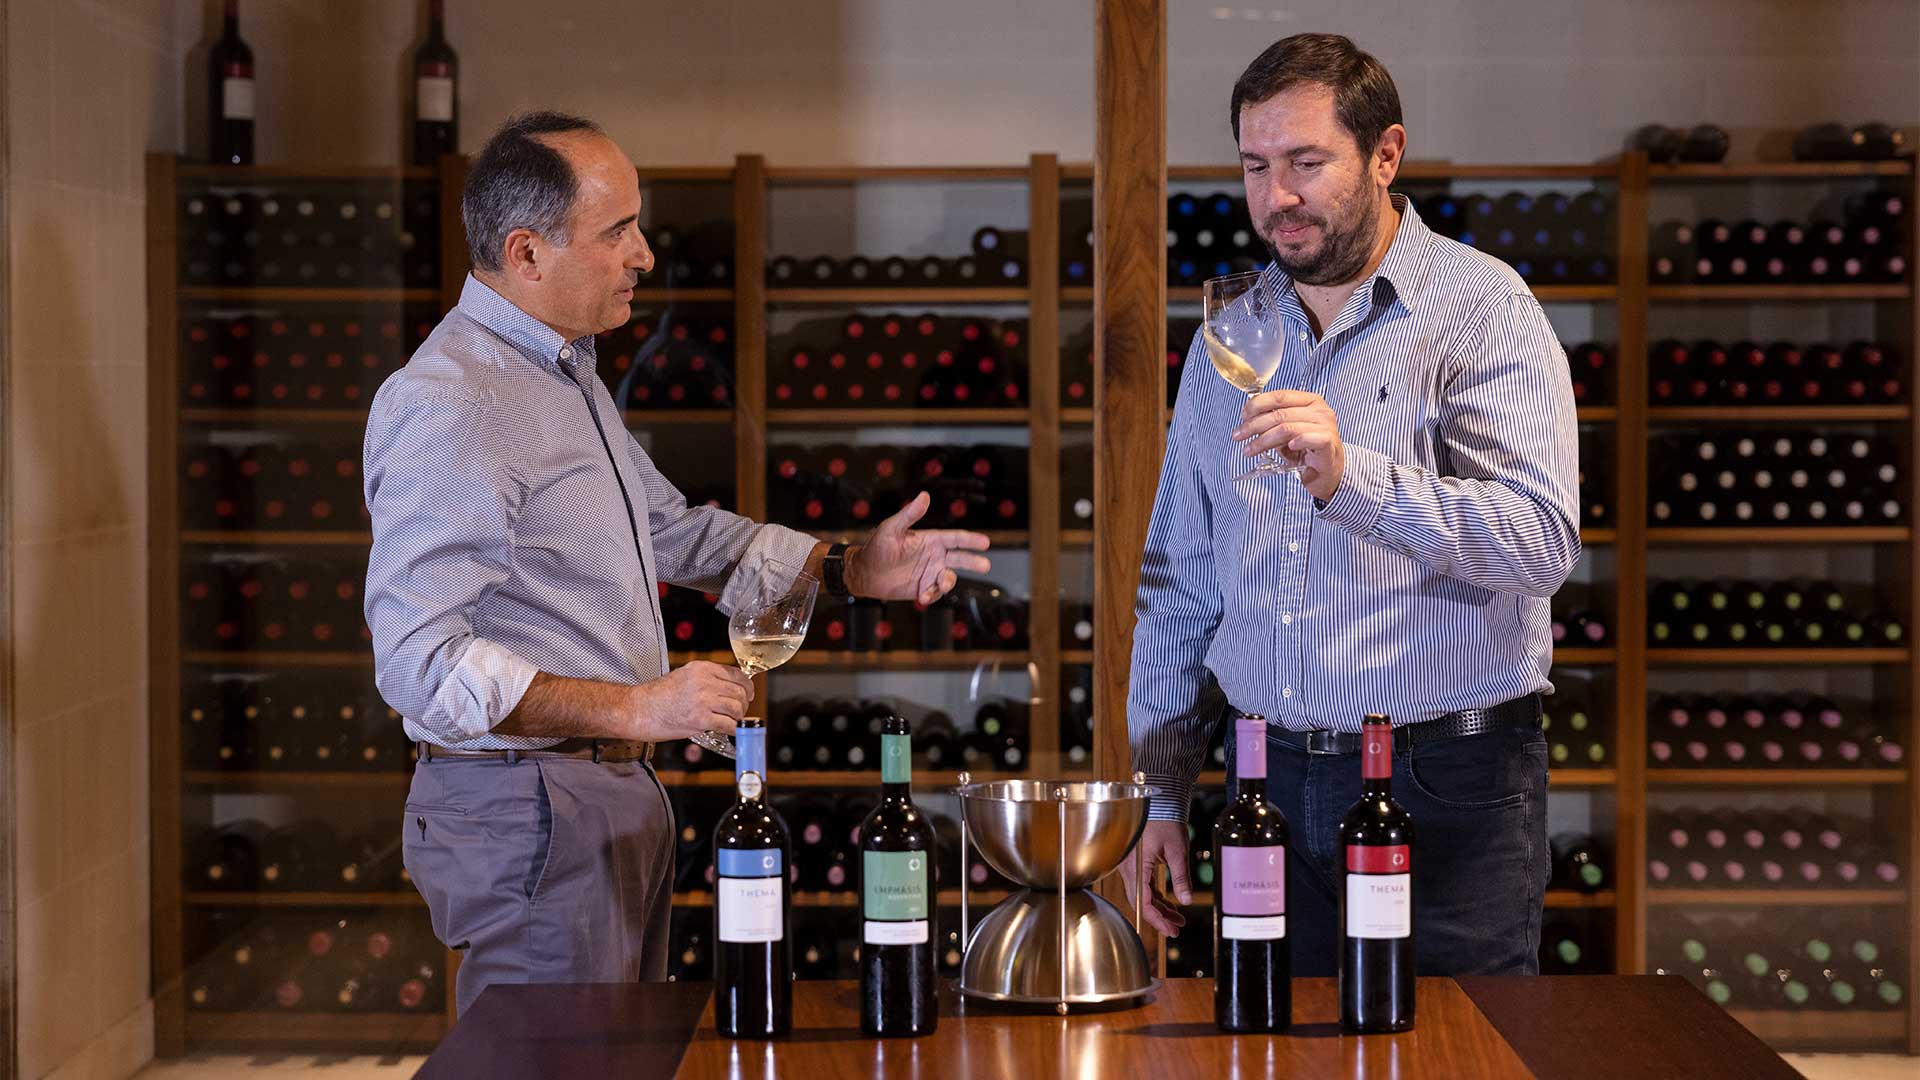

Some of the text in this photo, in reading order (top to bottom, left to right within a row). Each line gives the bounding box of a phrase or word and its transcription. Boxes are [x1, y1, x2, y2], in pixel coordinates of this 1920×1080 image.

[1233, 881, 1280, 889] EMPHASIS
[740, 889, 776, 897] THEMA
[874, 886, 921, 894] EMPHASIS
[1370, 885, 1405, 894] THEMA
